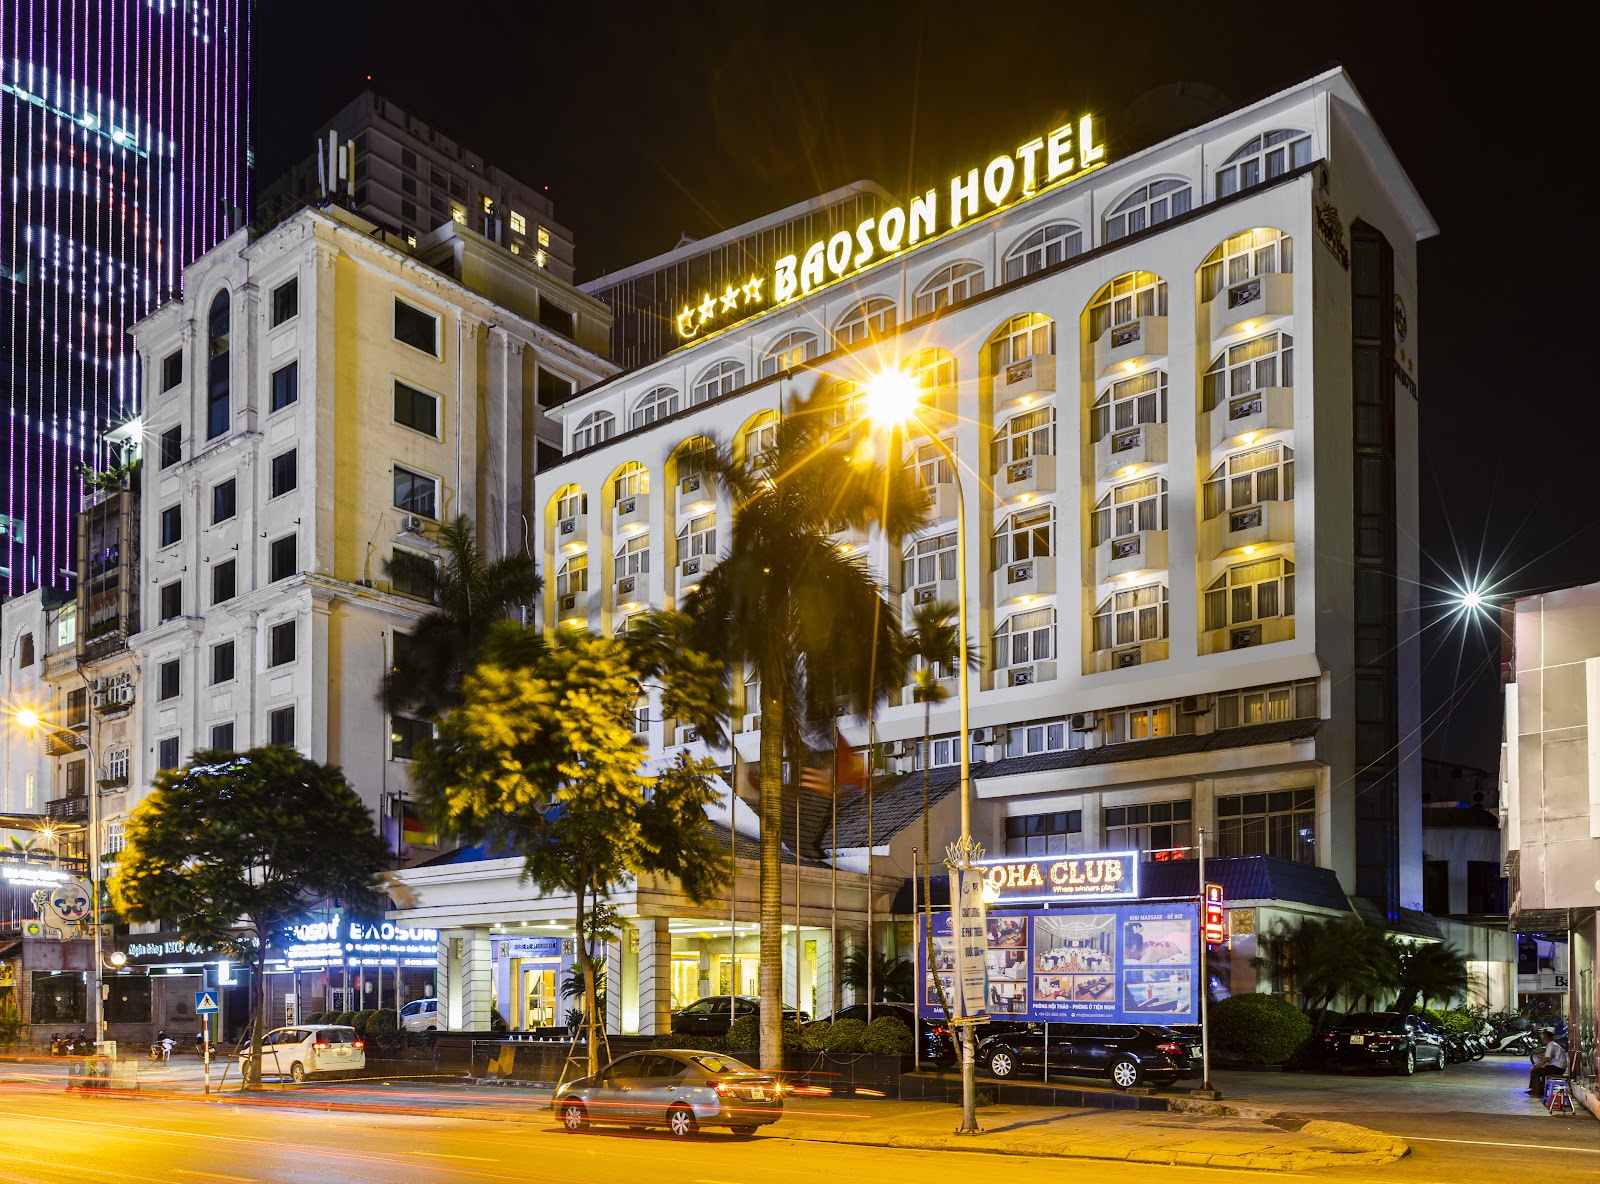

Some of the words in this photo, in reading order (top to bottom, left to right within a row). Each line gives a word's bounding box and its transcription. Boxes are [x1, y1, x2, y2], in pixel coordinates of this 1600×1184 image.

[774, 187, 937, 303] BAOSON
[950, 113, 1105, 229] HOTEL
[979, 862, 1044, 889] OHA
[1049, 859, 1123, 884] CLUB
[1053, 885, 1074, 893] Where
